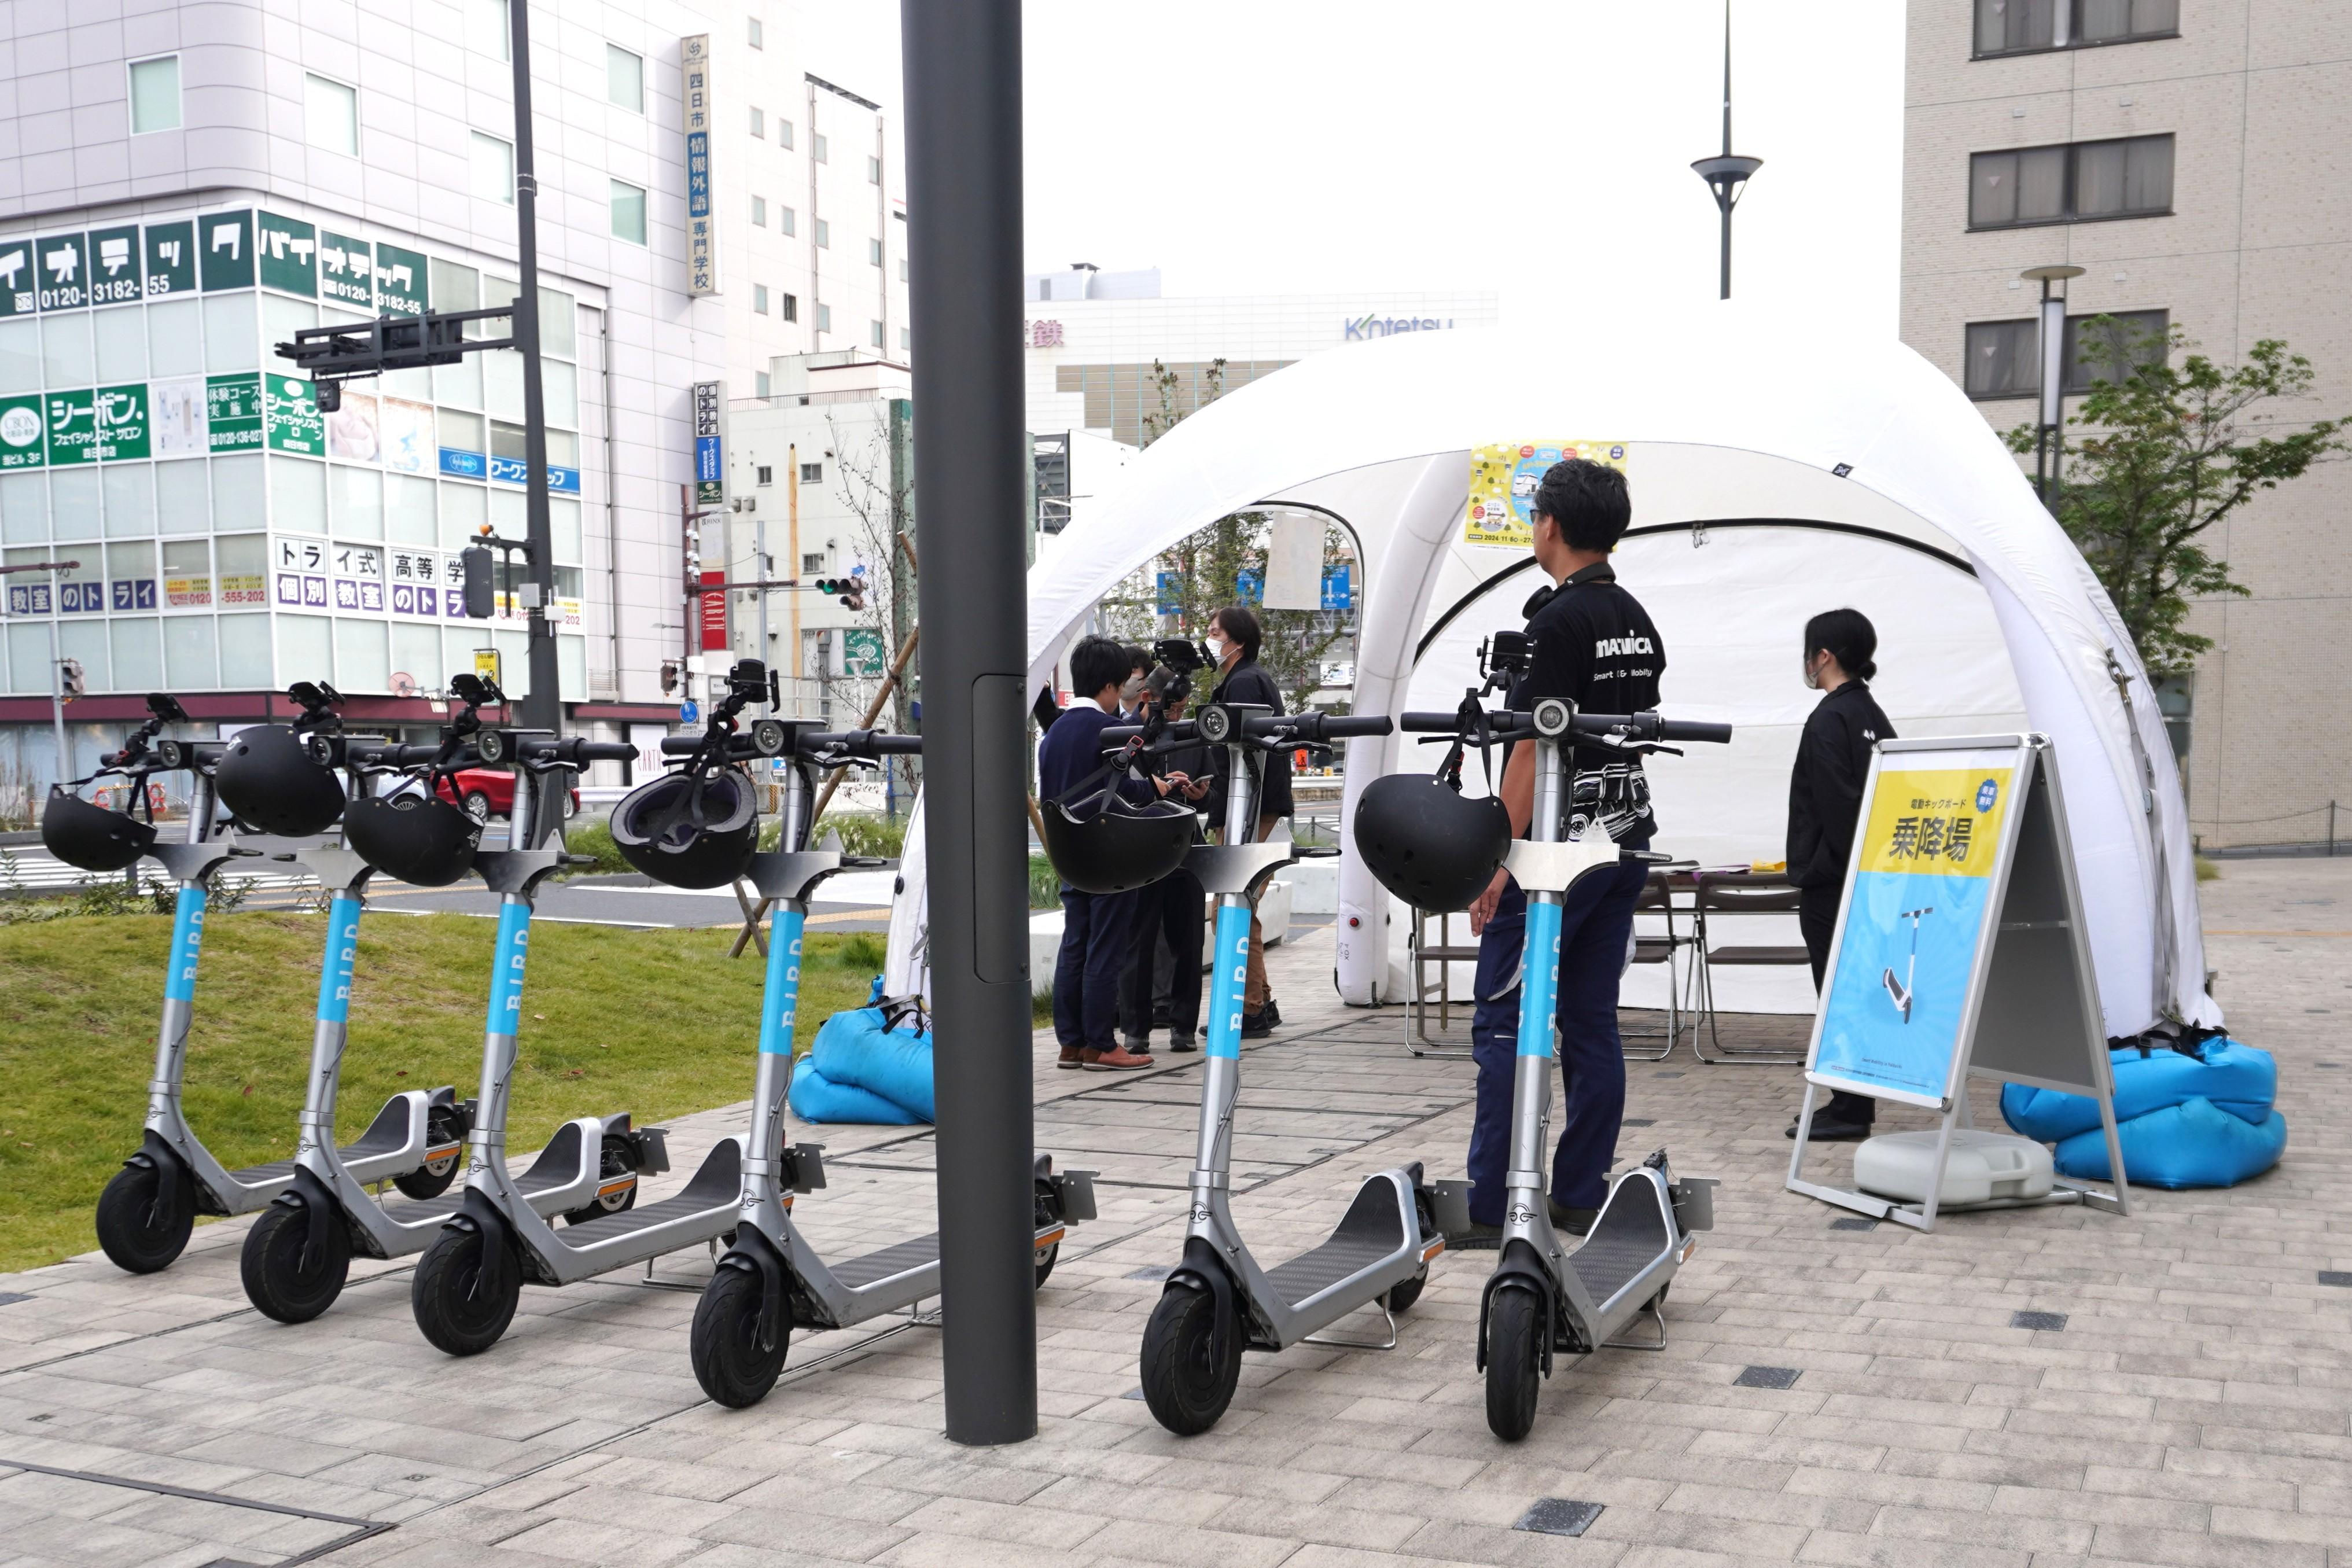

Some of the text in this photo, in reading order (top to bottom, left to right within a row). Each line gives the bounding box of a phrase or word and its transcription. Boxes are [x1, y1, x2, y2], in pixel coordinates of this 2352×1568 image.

[260, 229, 413, 292] バイオテック
[208, 385, 261, 402] 体験コース
[698, 385, 707, 435] のトライ
[708, 385, 717, 434] 個別教室
[705, 592, 724, 630] EARTH
[1593, 671, 1614, 681] Smart
[1911, 798, 1967, 810] 電動キックボード
[1889, 816, 1974, 862] 乗降場
[183, 910, 205, 981] BIRD
[335, 923, 359, 1001] BIRD
[506, 929, 529, 1011] BIRD
[782, 938, 803, 1029] BIRD
[1230, 936, 1250, 1032] BIRD
